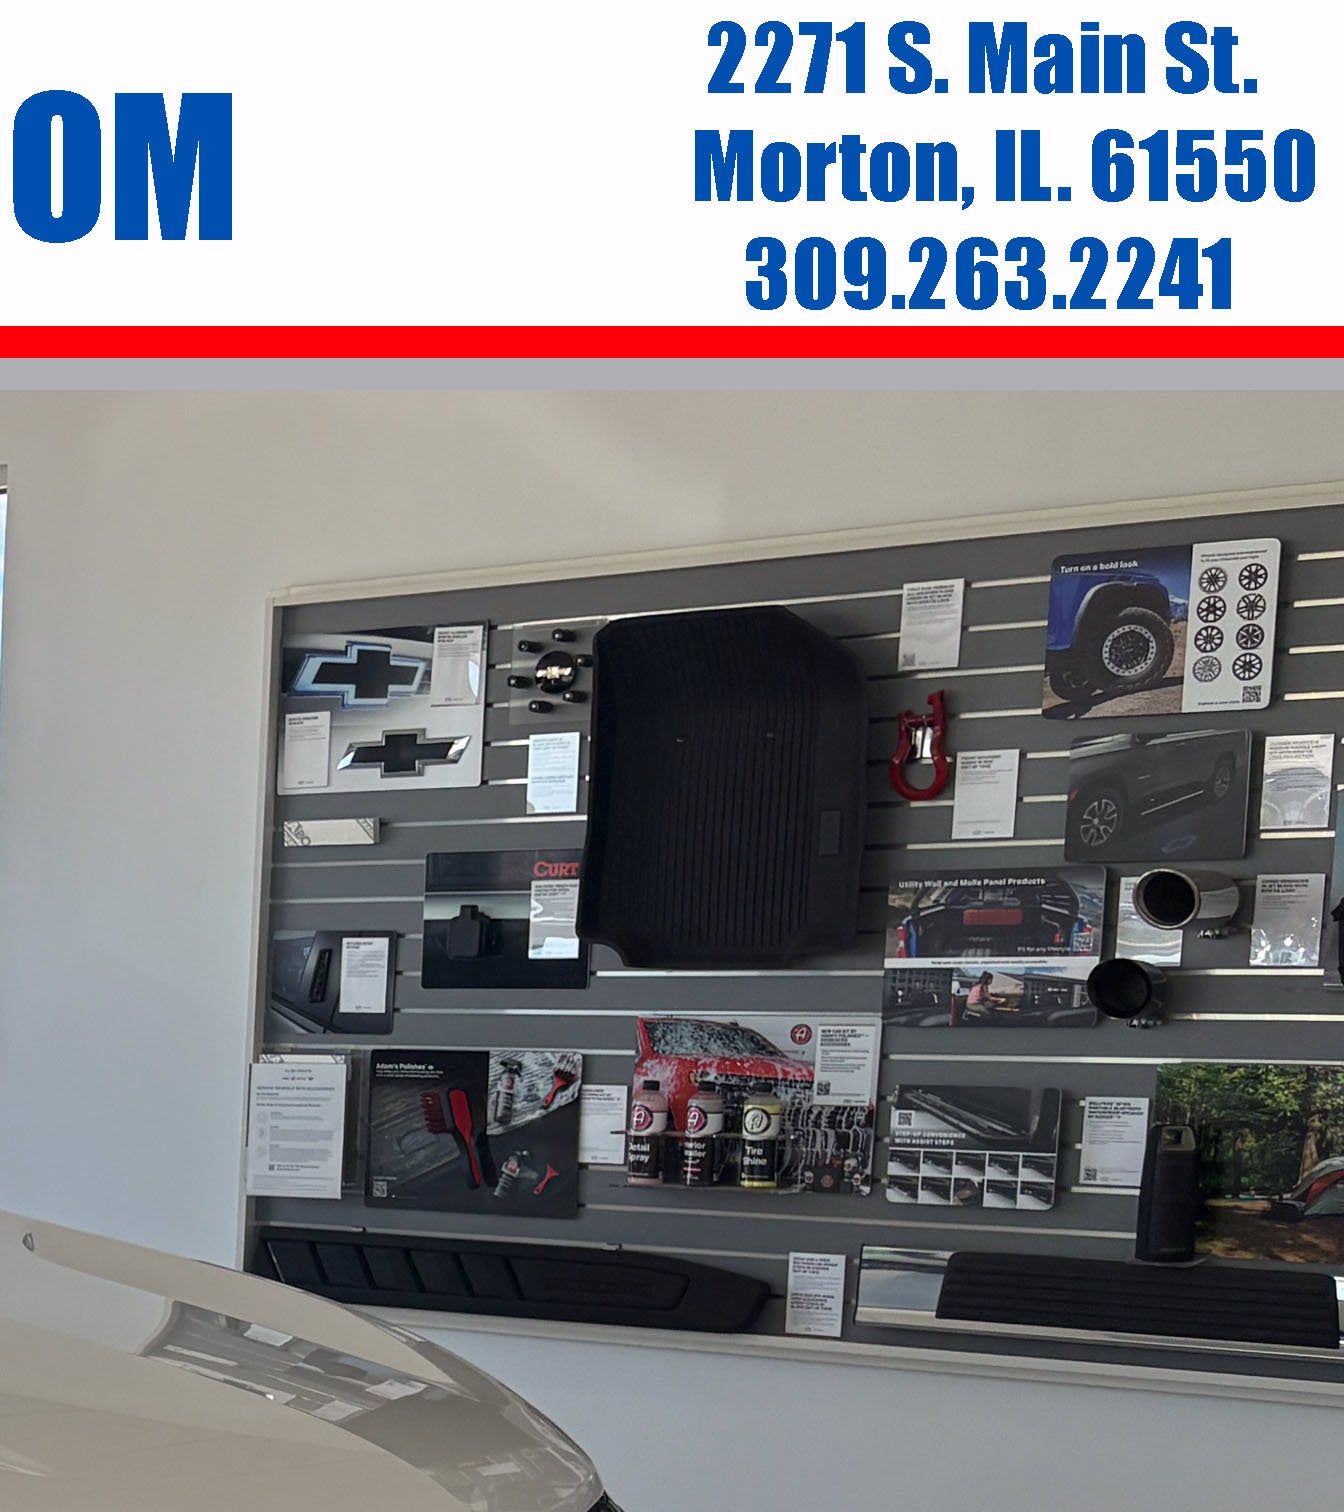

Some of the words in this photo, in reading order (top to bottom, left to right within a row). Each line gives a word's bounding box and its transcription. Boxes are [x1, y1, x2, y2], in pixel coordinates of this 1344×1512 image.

[1060, 566, 1079, 574] Turn
[1099, 562, 1119, 570] bold
[534, 861, 579, 877] CURT
[745, 1146, 764, 1156] Tire
